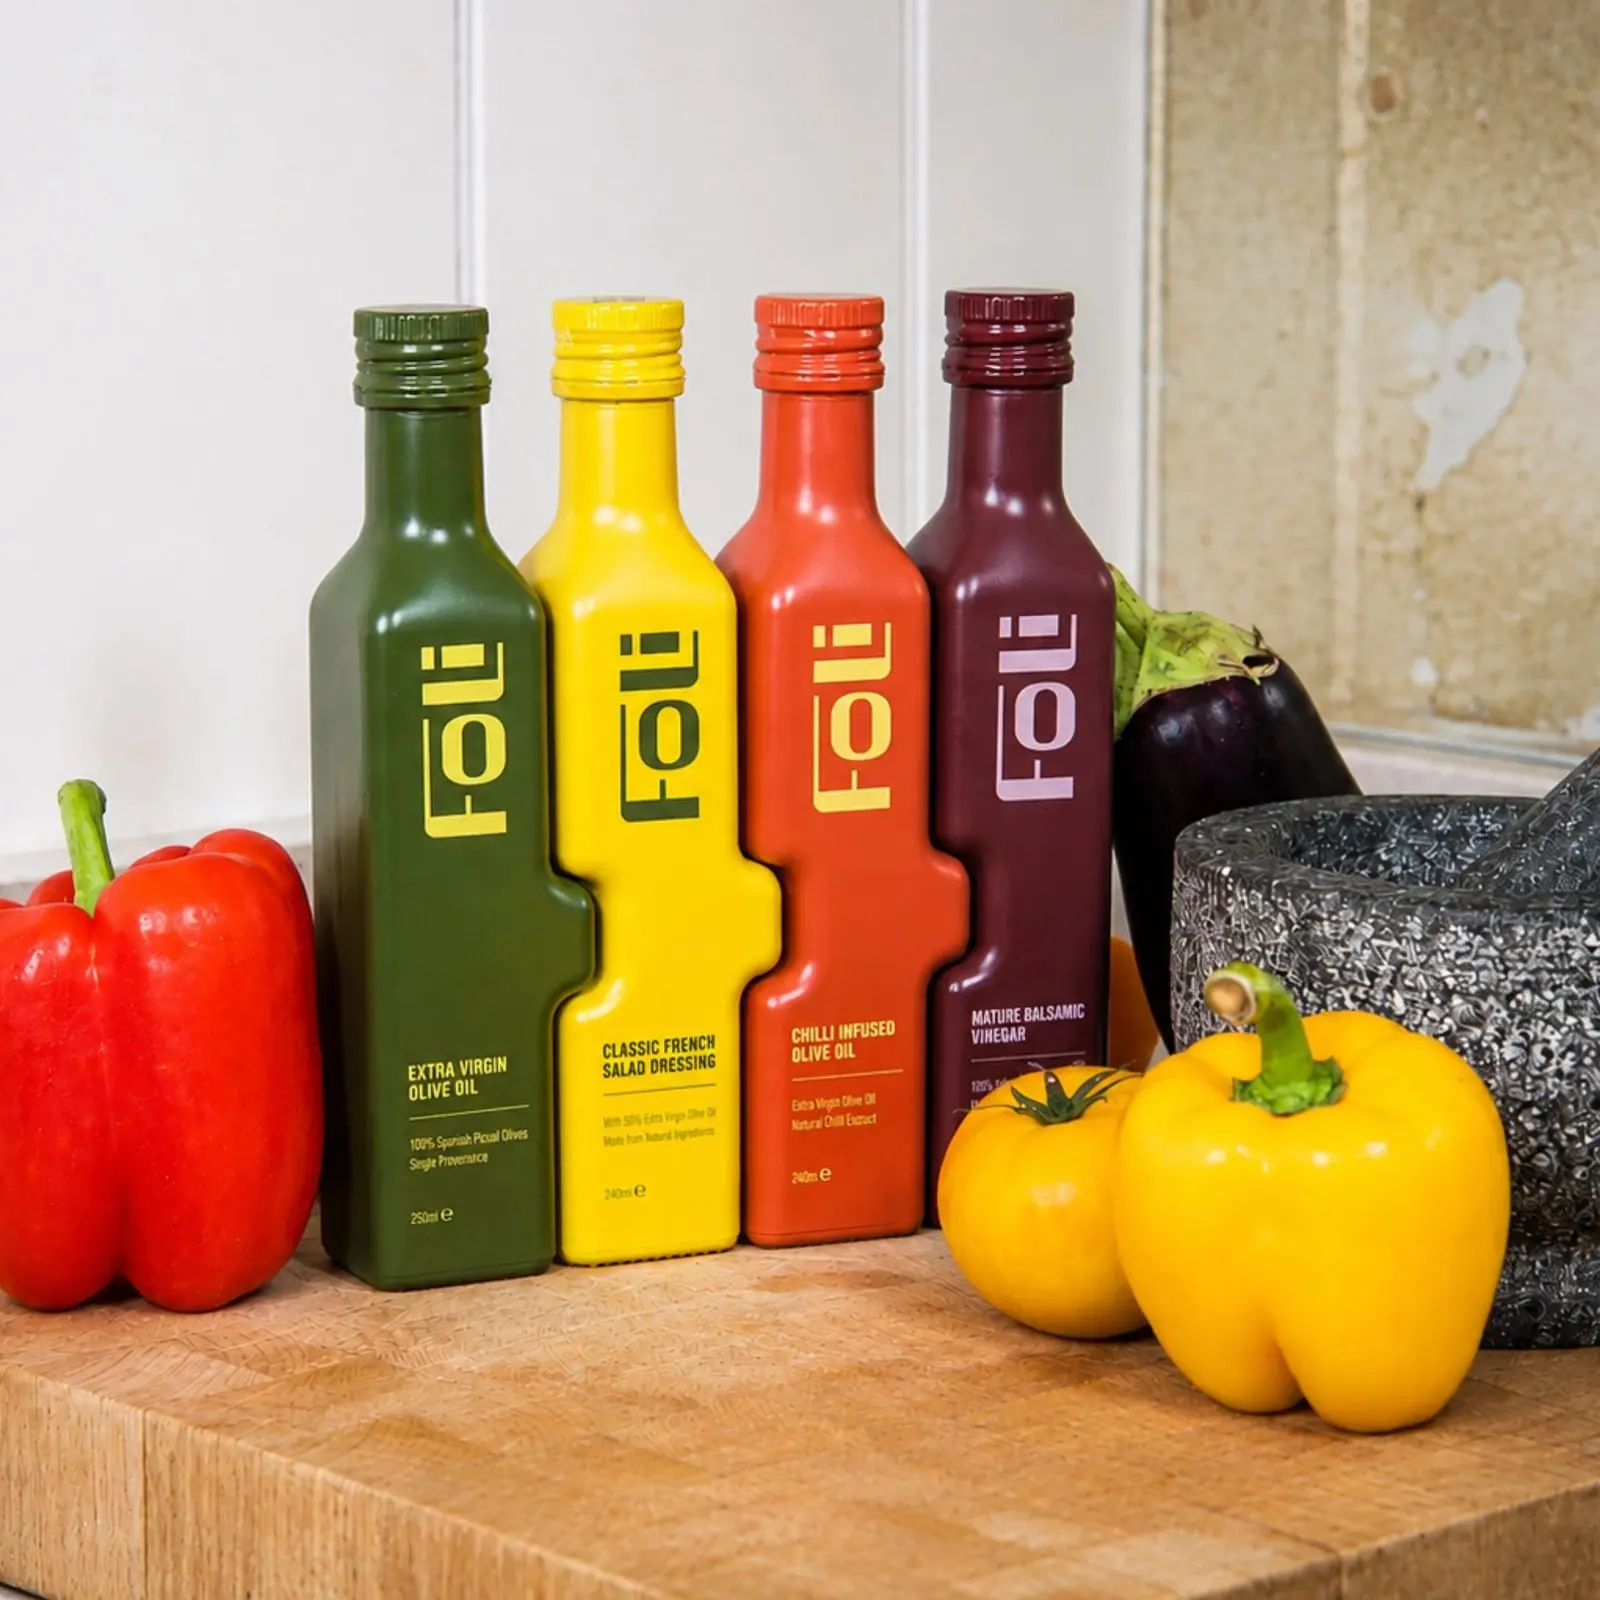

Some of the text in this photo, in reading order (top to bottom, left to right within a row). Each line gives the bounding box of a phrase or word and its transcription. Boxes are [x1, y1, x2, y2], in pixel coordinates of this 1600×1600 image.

[972, 1003, 1085, 1026] MATURE BALSAMIC
[791, 1020, 896, 1043] CHILLI INFUSED
[971, 1026, 1026, 1044] VINEGAR
[602, 1035, 716, 1059] CLASSIC FRENCH
[791, 1043, 856, 1063] OLIVE OIL
[408, 1056, 508, 1081] EXTRA VIRGIN
[602, 1054, 716, 1078] SALAD DRESSING
[408, 1079, 479, 1101] OLIVE OIL
[791, 1097, 815, 1111] Extra
[842, 1095, 862, 1107] Olive
[865, 1093, 876, 1105] Oil
[791, 1113, 877, 1130] Natural Chilli Extract
[410, 1138, 435, 1151] 100%
[437, 1134, 472, 1152] Spanish
[502, 1128, 528, 1141] Olives
[645, 1131, 672, 1142] Natural
[409, 1152, 488, 1172] Single Provenance
[410, 1211, 438, 1225] 250ml
